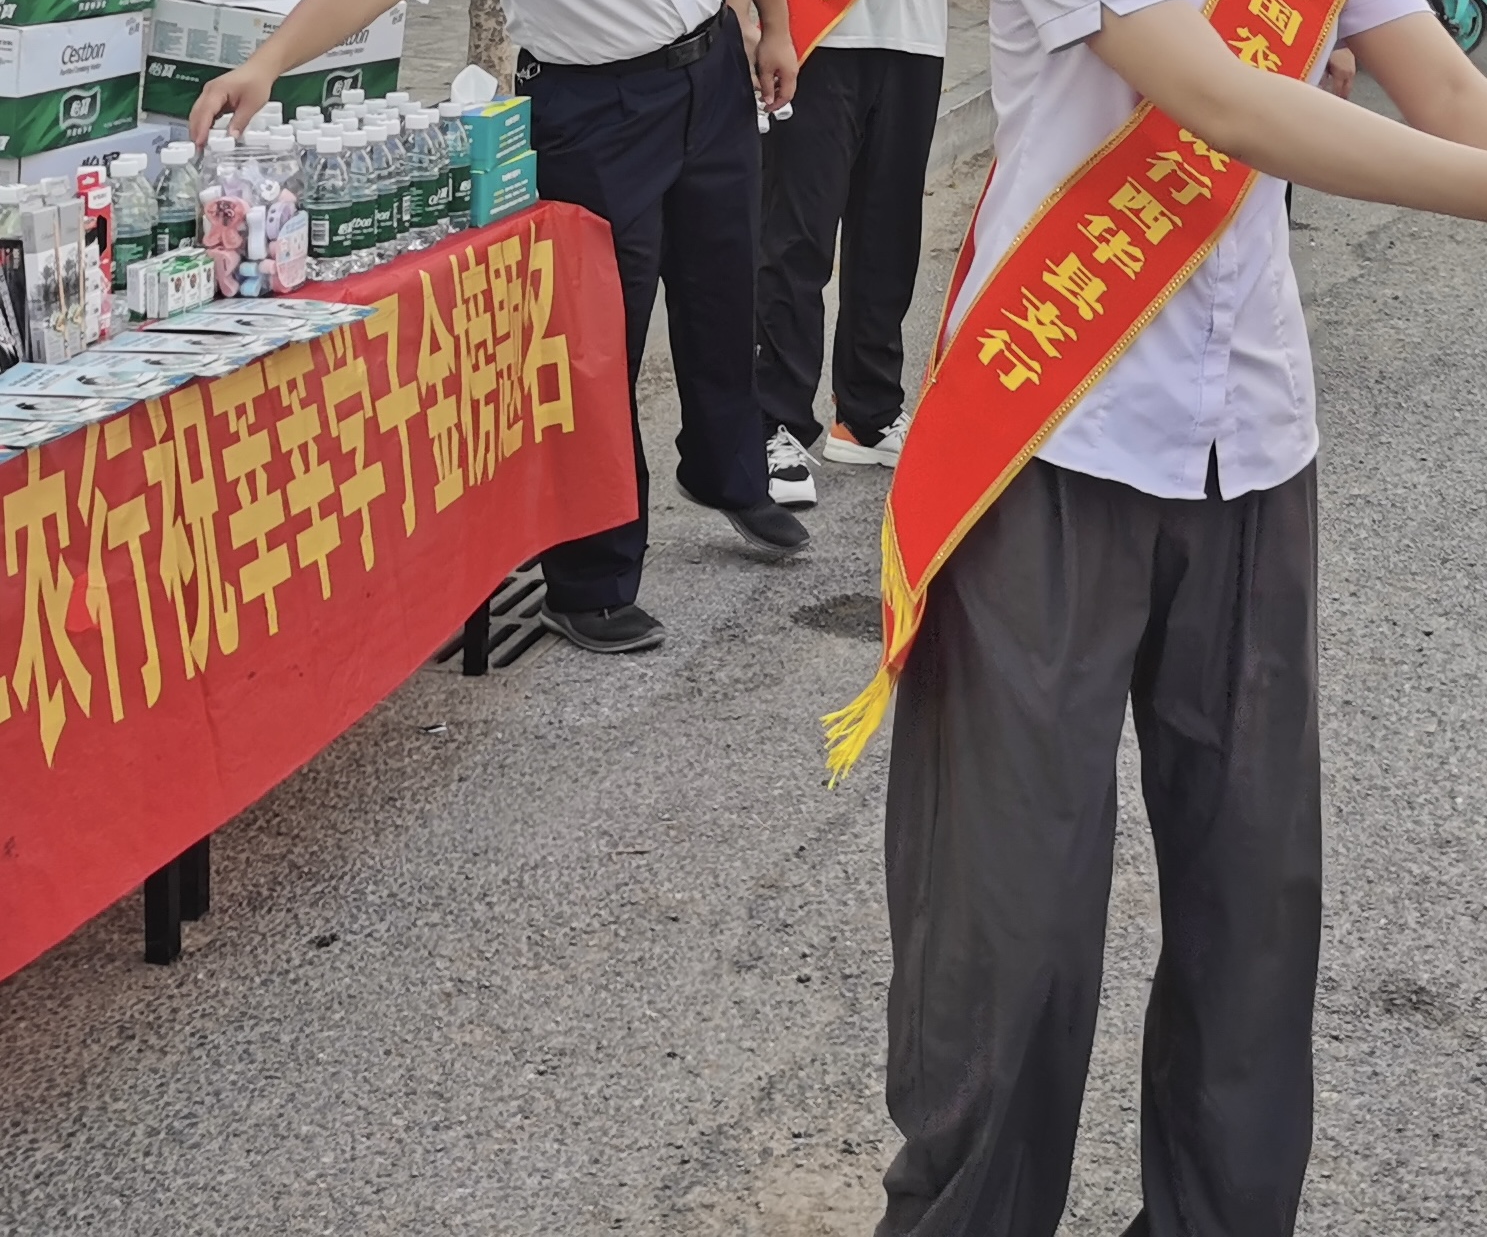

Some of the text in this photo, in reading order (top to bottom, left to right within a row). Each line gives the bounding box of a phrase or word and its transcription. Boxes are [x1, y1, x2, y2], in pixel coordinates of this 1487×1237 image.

[0, 220, 575, 769] 农行祝莘莘学子金榜题名
